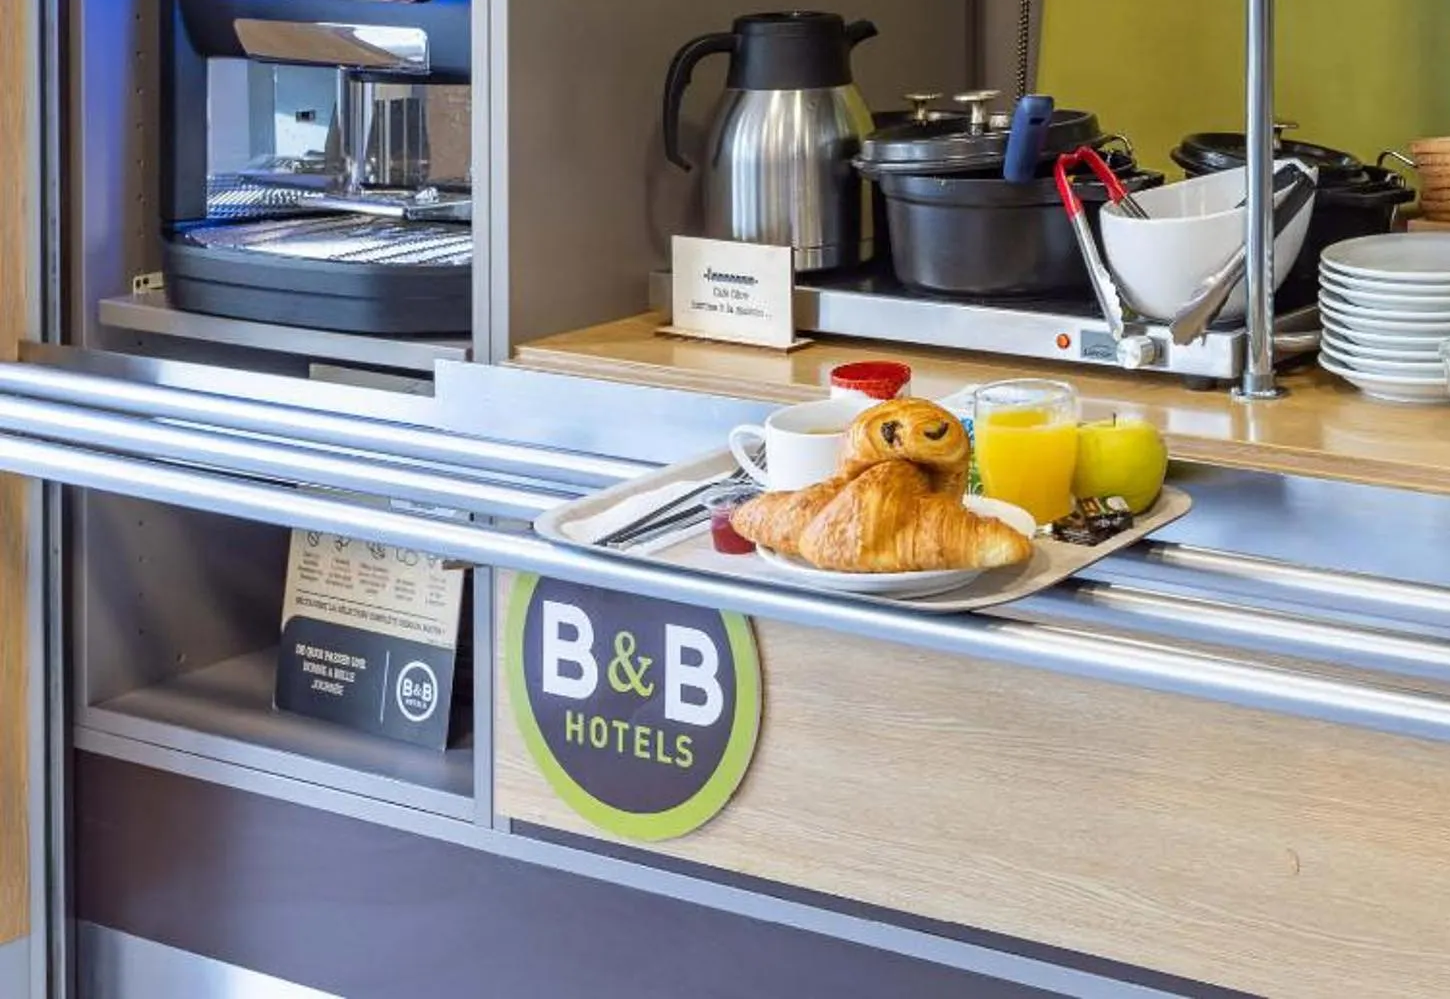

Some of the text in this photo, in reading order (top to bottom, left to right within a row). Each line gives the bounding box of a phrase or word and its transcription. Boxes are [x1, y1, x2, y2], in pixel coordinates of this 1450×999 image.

[401, 678, 433, 702] B&B
[541, 599, 725, 727] B&B
[565, 709, 694, 769] HOTELS
